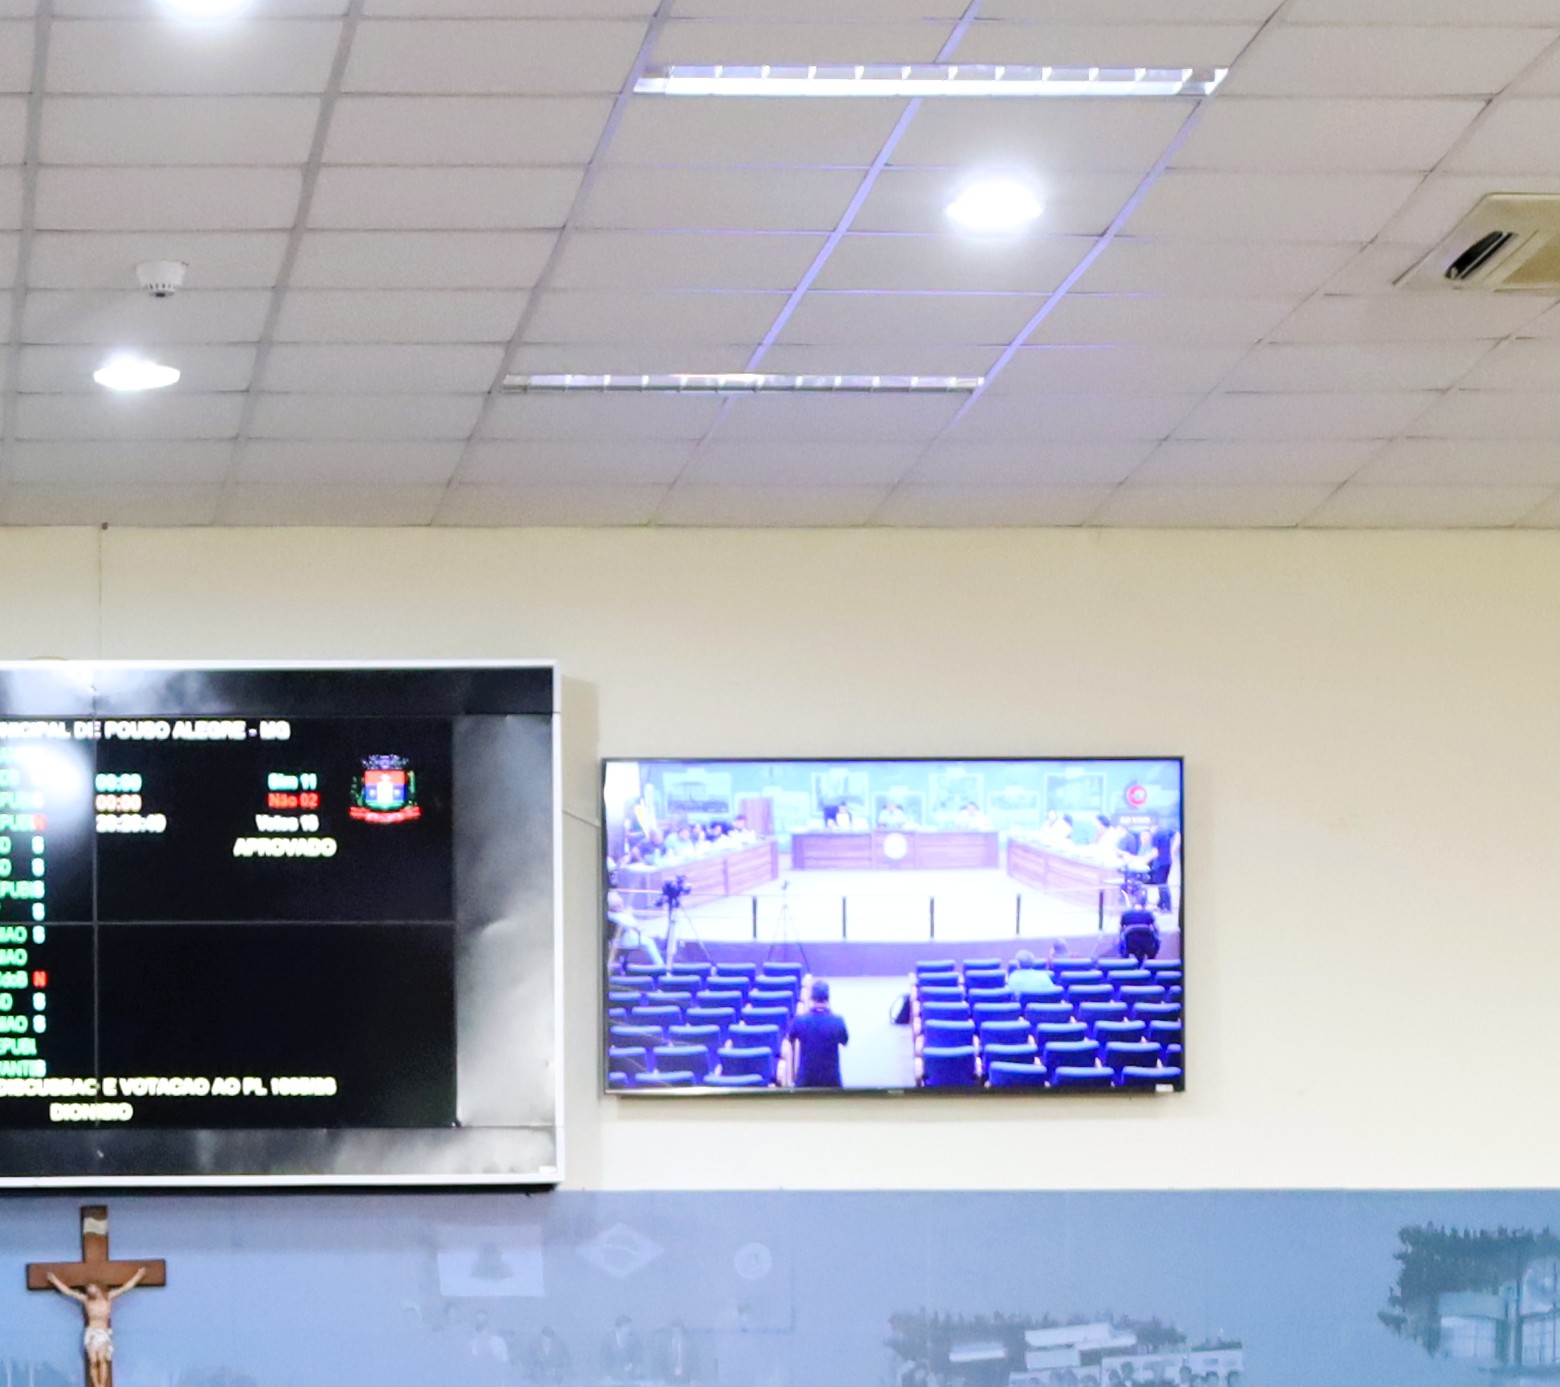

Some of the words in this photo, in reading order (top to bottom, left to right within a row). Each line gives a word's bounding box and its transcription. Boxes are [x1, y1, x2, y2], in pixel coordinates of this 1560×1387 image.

[74, 721, 101, 740] DE
[104, 721, 171, 740] POUSO
[172, 721, 247, 740] ALEGRE
[260, 721, 291, 740] MG
[267, 793, 298, 809] Não
[299, 793, 320, 809] 02
[233, 838, 337, 857] APROVADO
[32, 969, 48, 988] N
[102, 1077, 118, 1096] E
[211, 1077, 242, 1096] AO
[242, 1077, 268, 1096] PL
